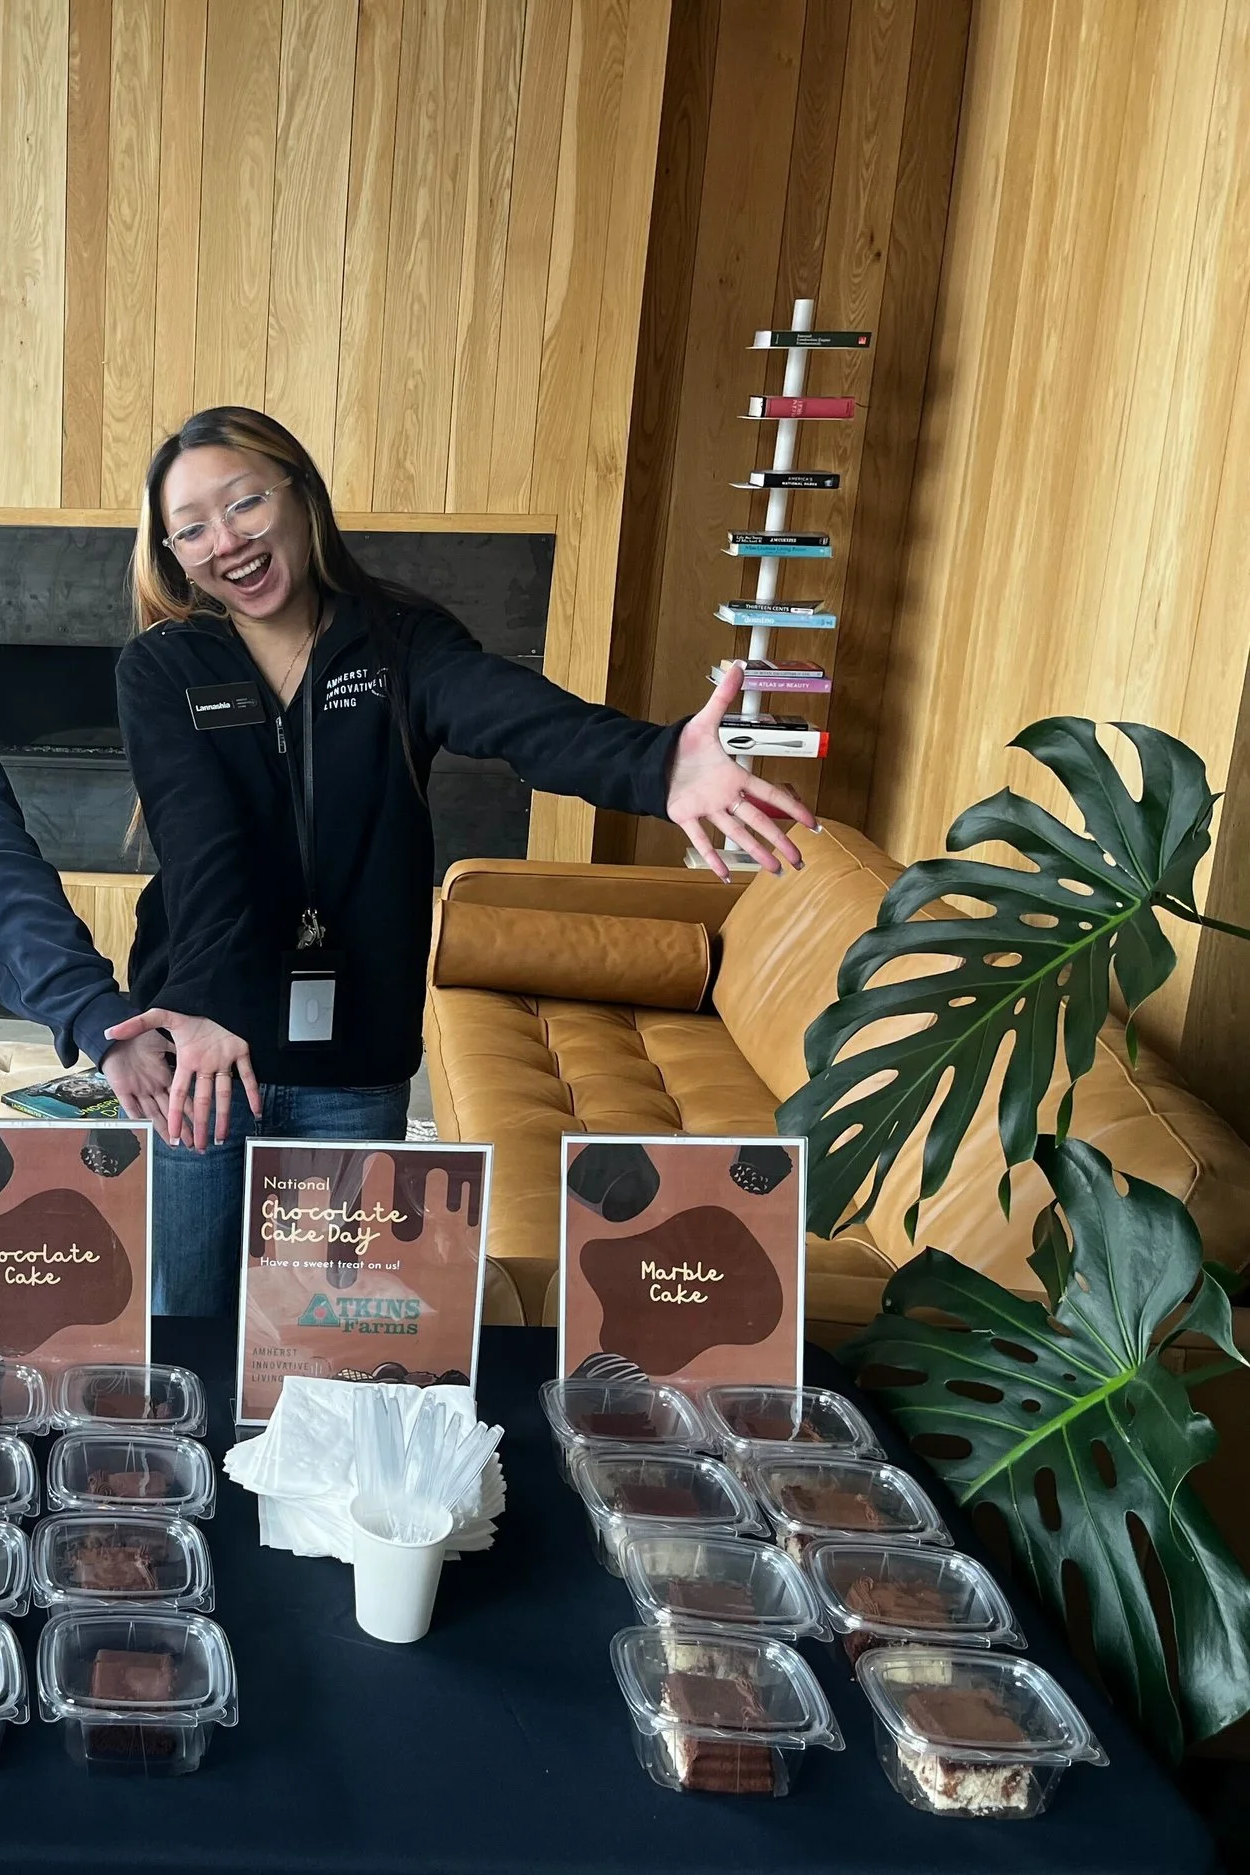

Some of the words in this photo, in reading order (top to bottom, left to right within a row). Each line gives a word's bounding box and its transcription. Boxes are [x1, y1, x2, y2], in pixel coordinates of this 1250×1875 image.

[744, 616, 774, 624] domino
[326, 669, 368, 689] AMHERST
[326, 678, 377, 701] INNOVATIVE
[324, 698, 356, 711] LIVING
[264, 1176, 330, 1191] National
[262, 1200, 408, 1223] Chocolate
[260, 1223, 324, 1244] Cake
[328, 1225, 380, 1255] Day
[260, 1257, 289, 1268] Have
[303, 1260, 334, 1269] sweet
[338, 1260, 364, 1269] treat
[385, 1260, 401, 1270] us!
[641, 1261, 724, 1282] Marble
[5, 1266, 61, 1286] Cake
[650, 1284, 708, 1304] Cake
[297, 1293, 421, 1327] ATKINS
[342, 1318, 418, 1335] Farms
[252, 1348, 297, 1357] AMHERST
[252, 1361, 309, 1371] INNOVATIVE
[252, 1374, 283, 1383] LIVING
